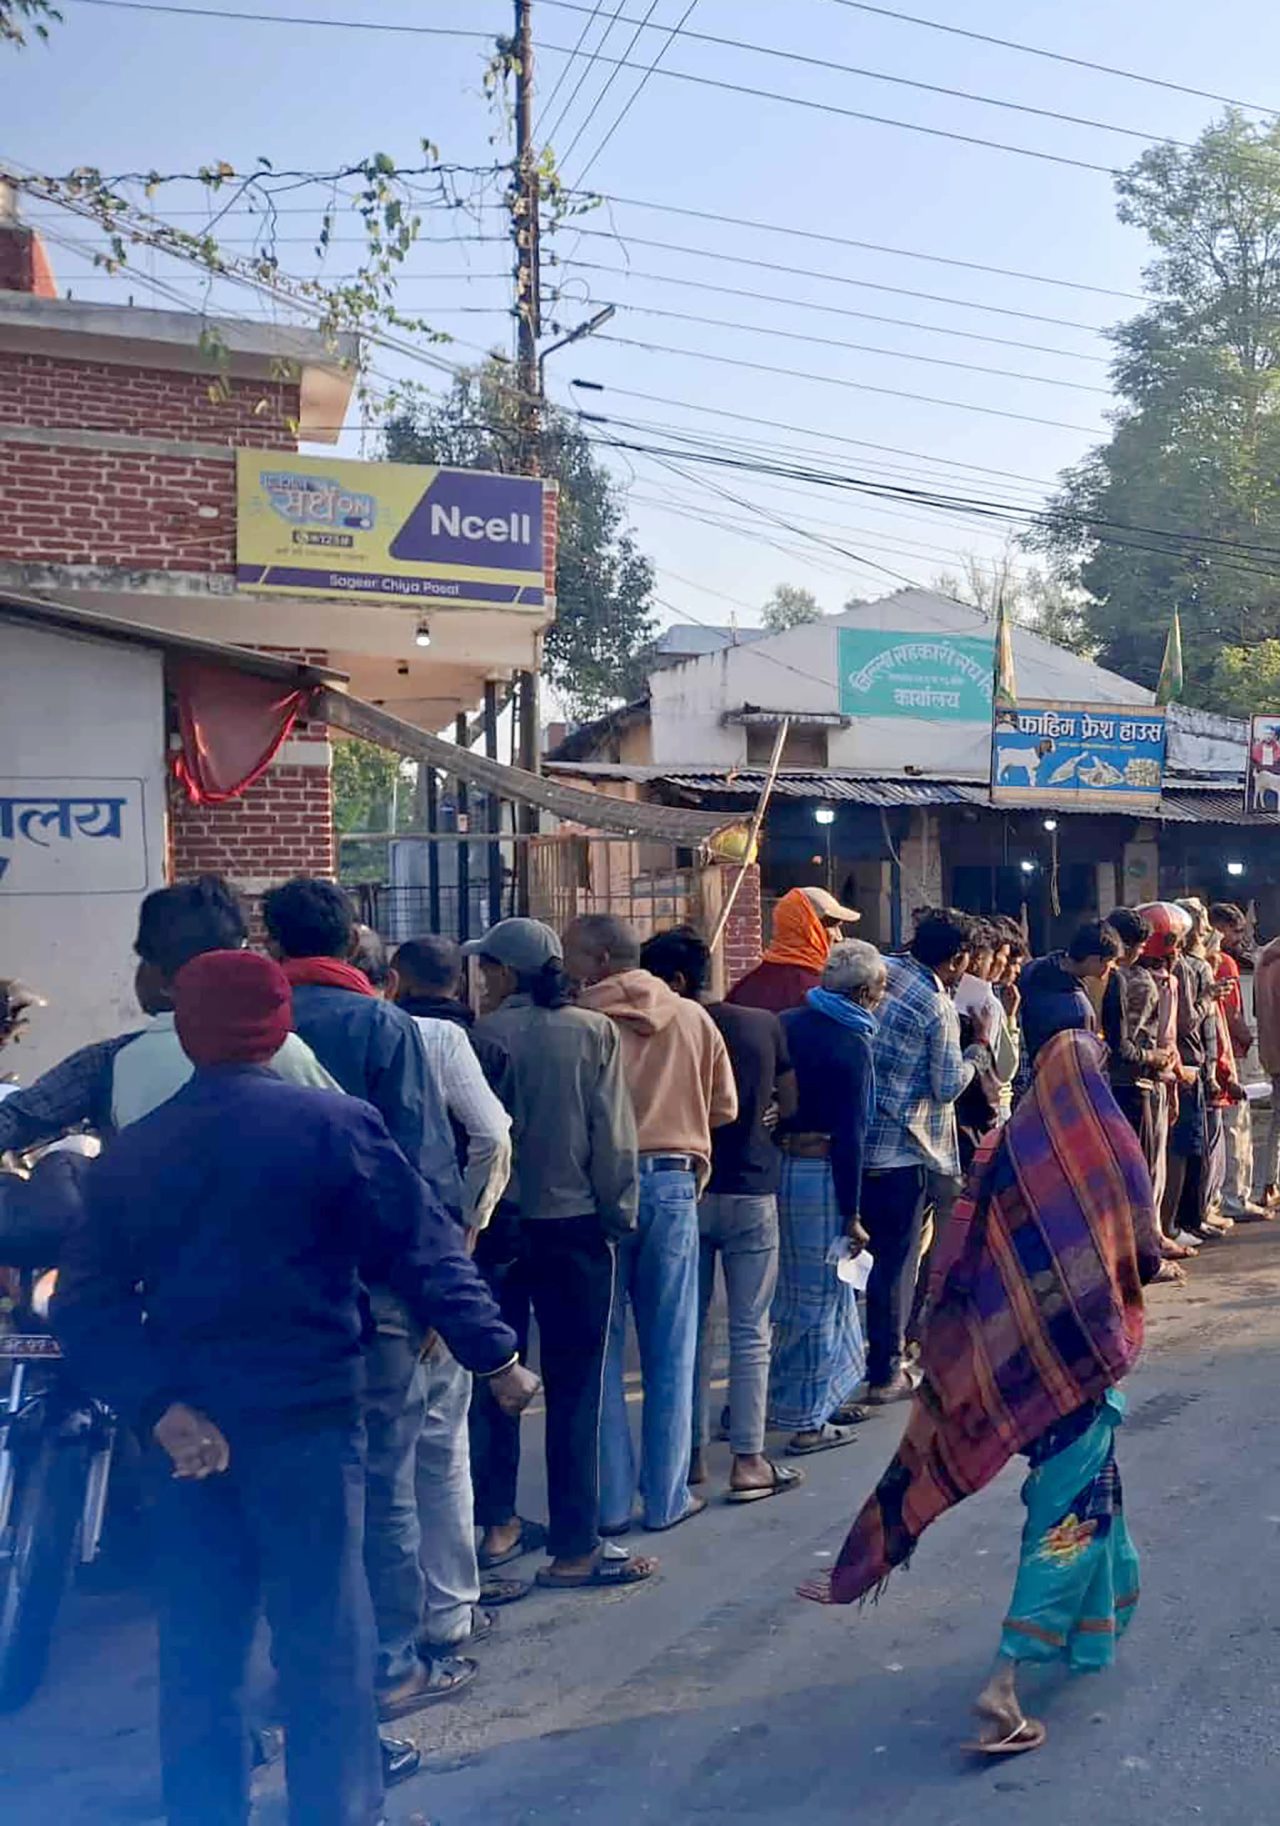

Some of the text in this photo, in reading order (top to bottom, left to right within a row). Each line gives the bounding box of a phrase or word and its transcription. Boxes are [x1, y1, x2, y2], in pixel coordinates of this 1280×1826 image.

[431, 503, 530, 545] Ncell
[381, 577, 420, 593] Chiya
[893, 686, 960, 708] कार्यालय
[1019, 712, 1162, 742] फाहिम फ्रेश हाउस
